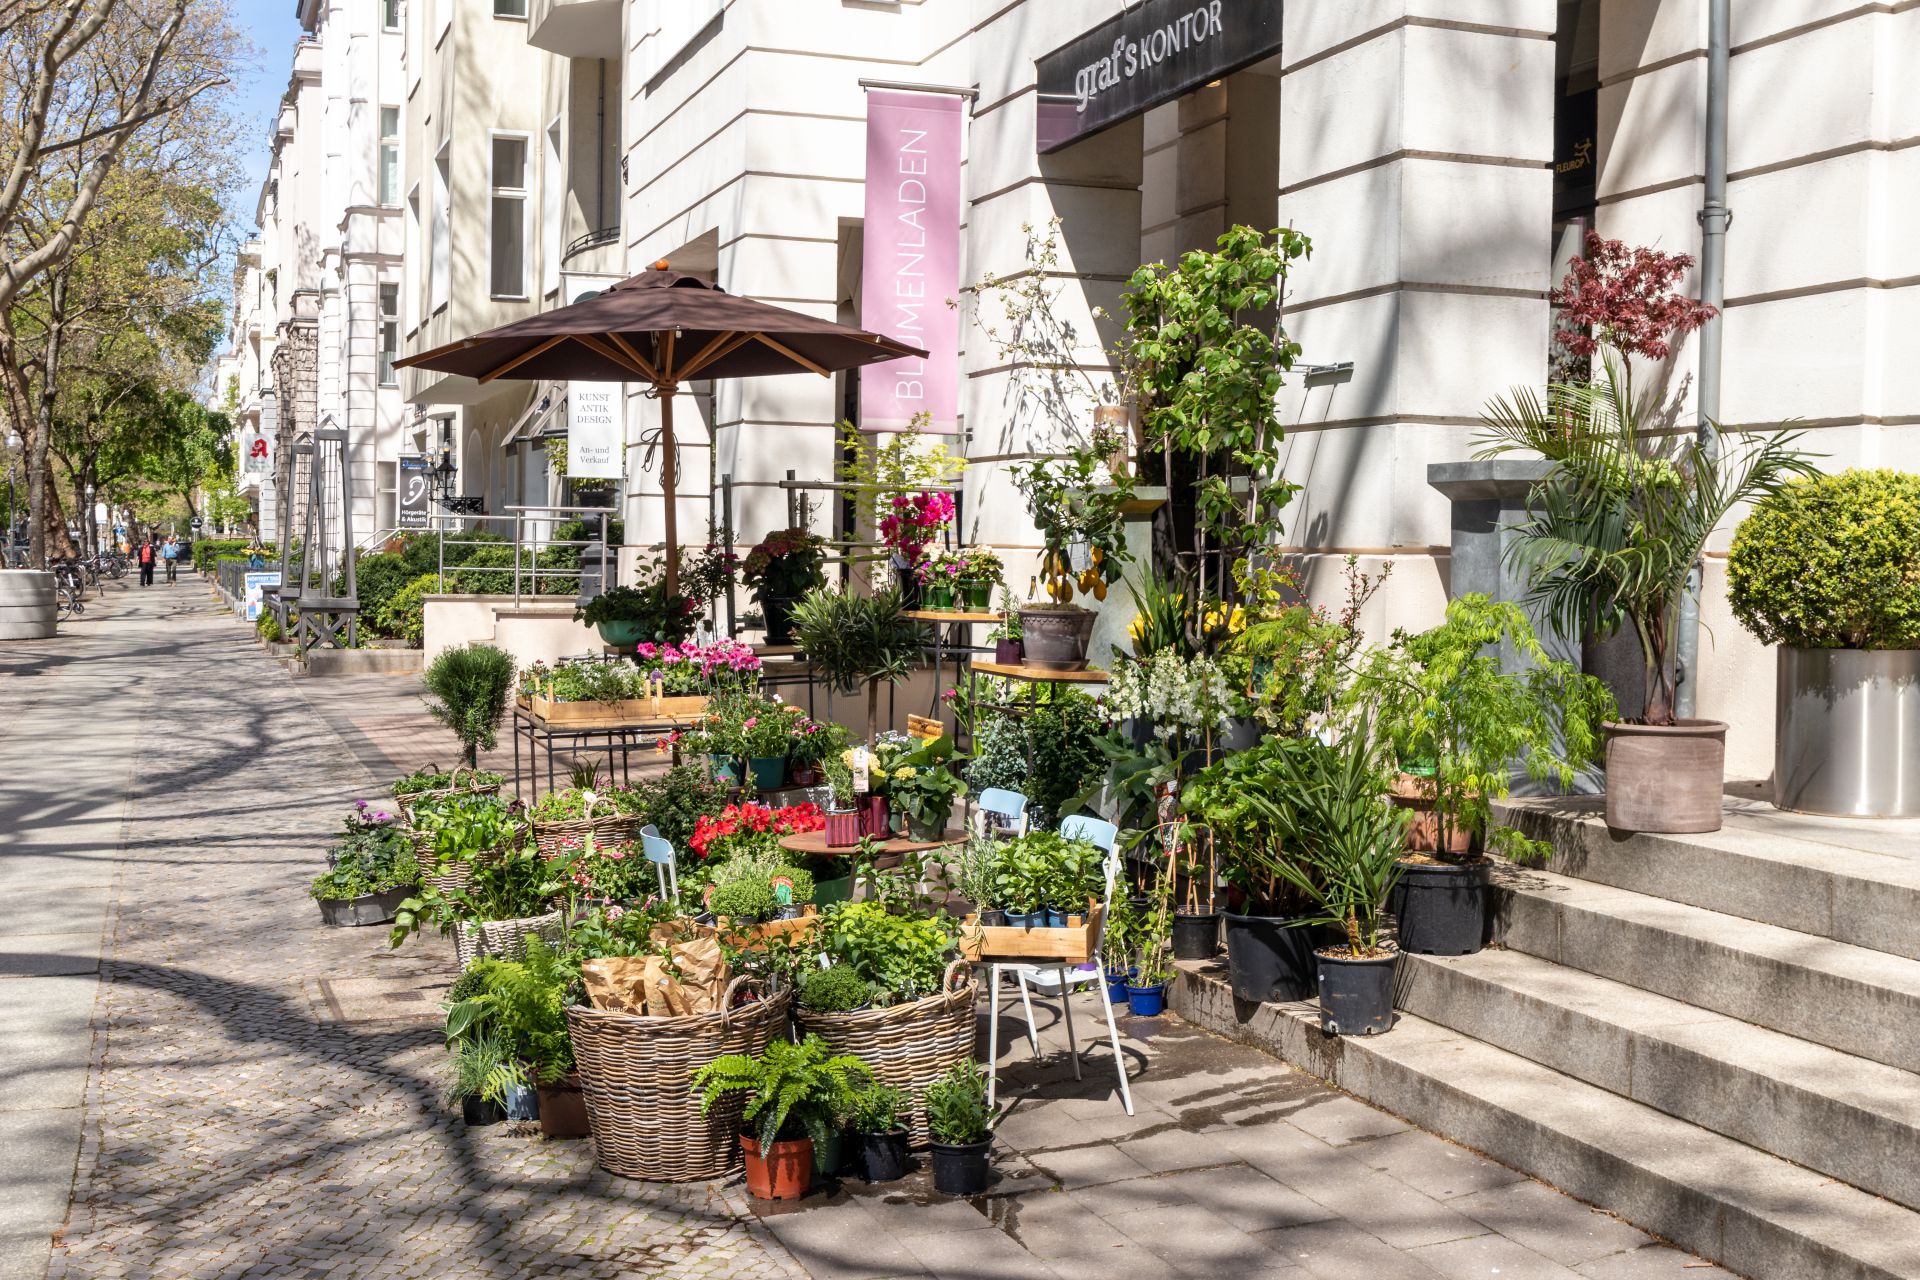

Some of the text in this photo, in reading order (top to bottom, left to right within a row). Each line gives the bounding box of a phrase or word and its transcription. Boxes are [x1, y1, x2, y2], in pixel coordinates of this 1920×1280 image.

[1075, 0, 1222, 112] graf's KONTOR
[579, 393, 610, 401] KUNST
[577, 415, 612, 424] DESIGN
[580, 456, 609, 464] Verkauf
